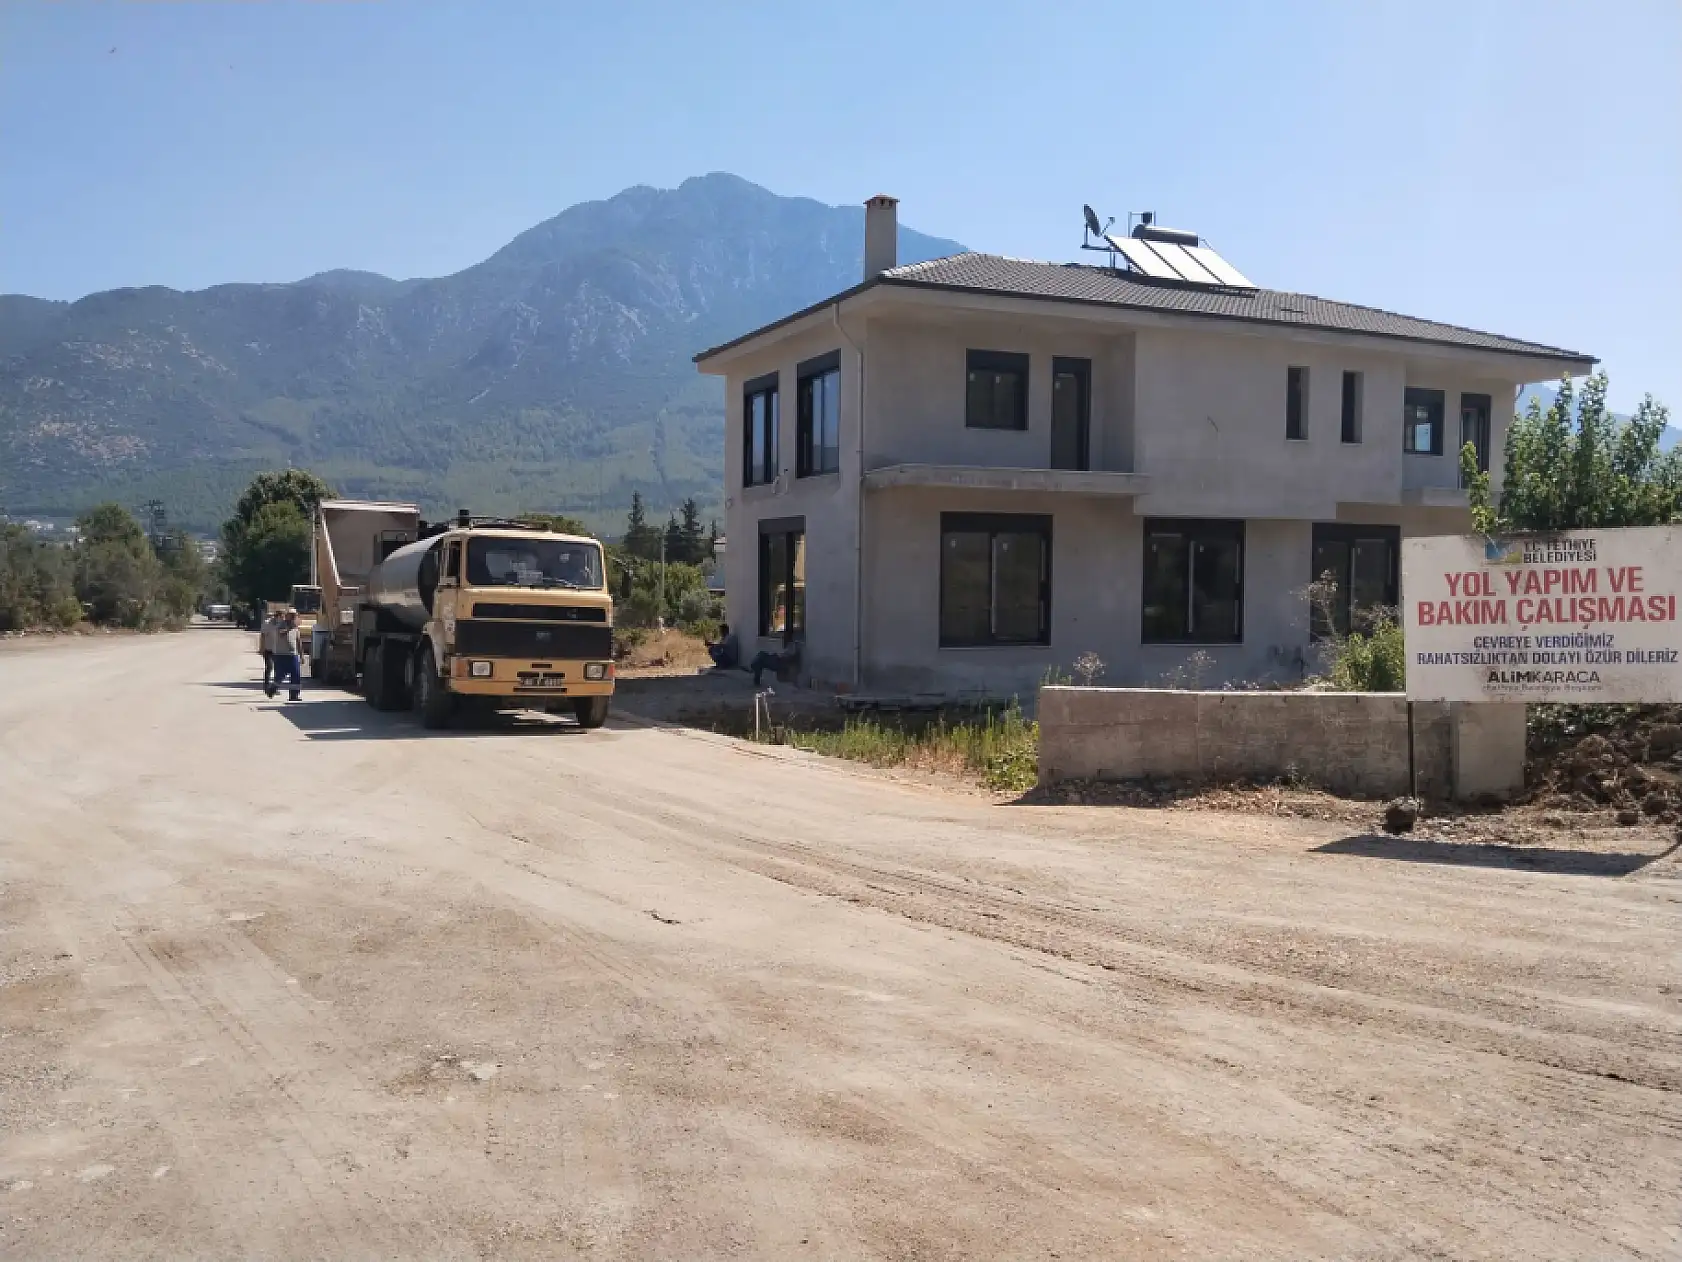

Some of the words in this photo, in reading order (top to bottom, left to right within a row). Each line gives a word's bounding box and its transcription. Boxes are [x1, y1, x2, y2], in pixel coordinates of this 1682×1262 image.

[1444, 571, 1497, 597] YOL
[1505, 567, 1597, 595] YAPIM
[1607, 566, 1644, 593] VE
[1418, 600, 1508, 626] BAKIM
[1516, 595, 1676, 632] ÇALIŞMASI
[1534, 632, 1615, 649] VERDİĞİMİZ
[1416, 652, 1528, 665] RAHATSIZLIKTAN
[1532, 651, 1581, 665] DOLAYI
[1585, 648, 1622, 665] ÖZÜR
[1626, 648, 1679, 664] DİLERİZ
